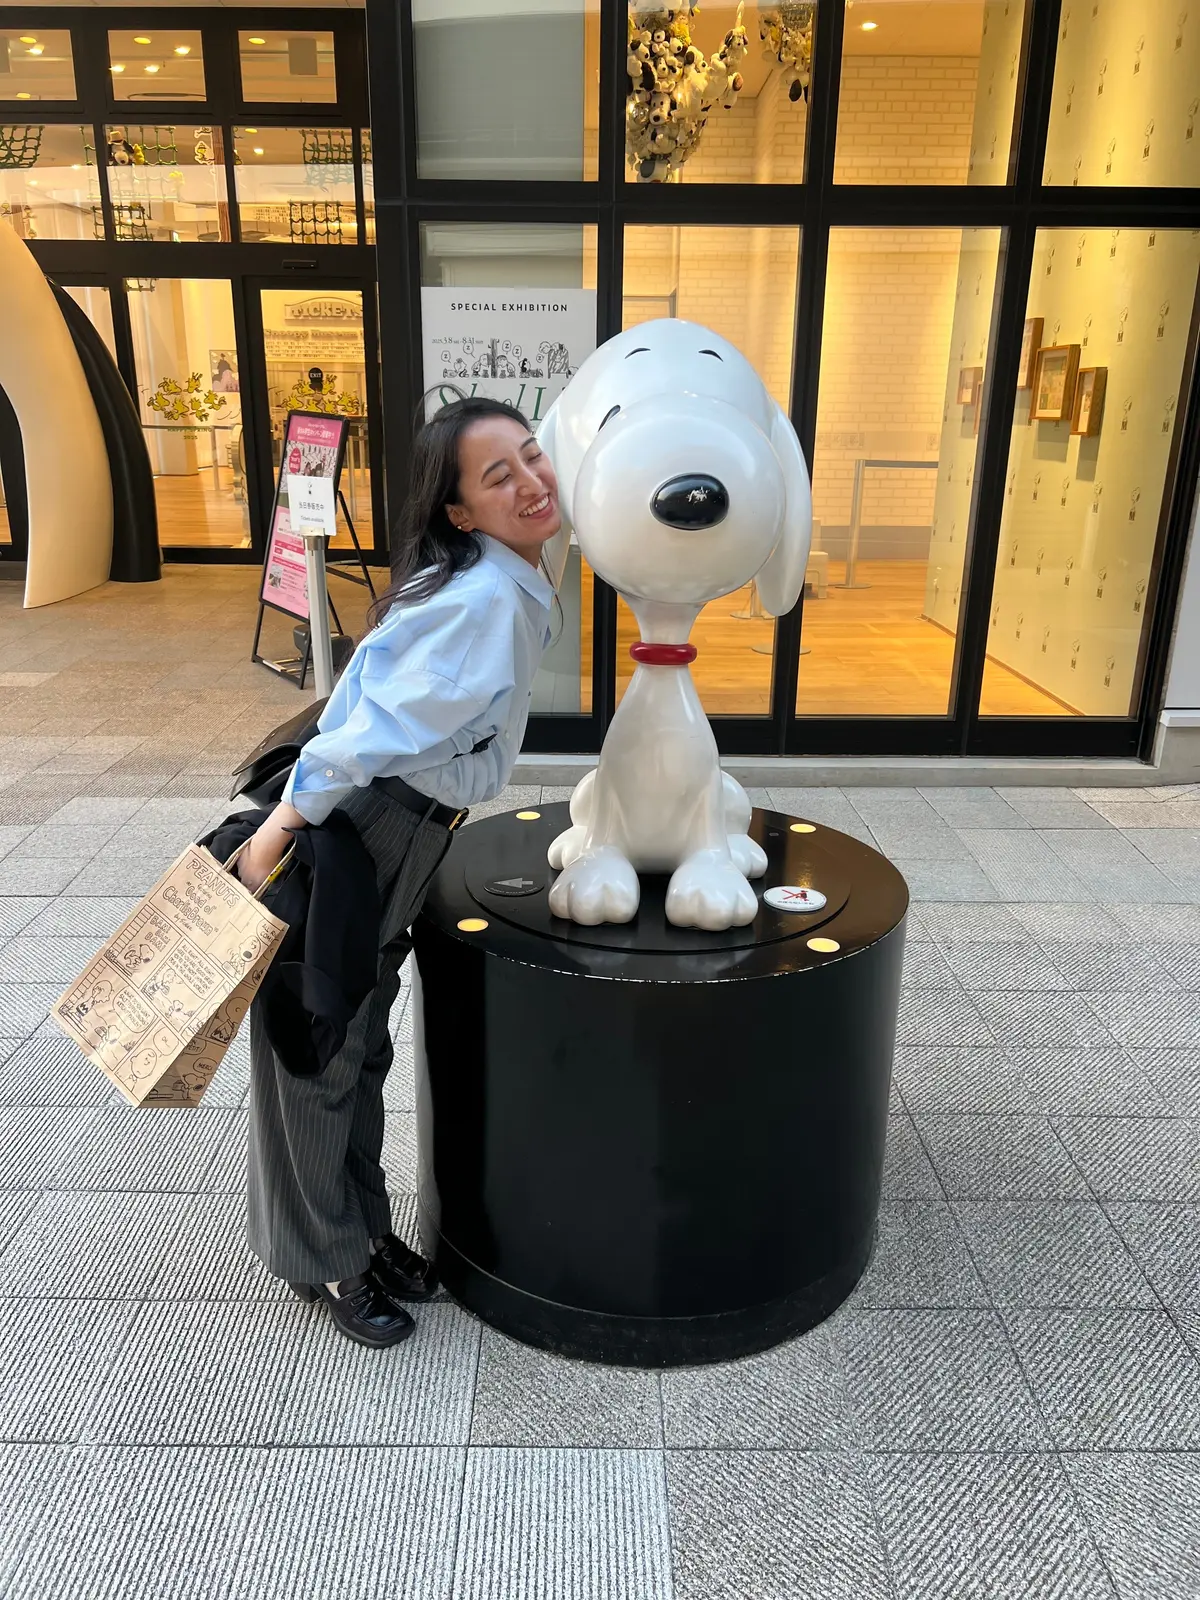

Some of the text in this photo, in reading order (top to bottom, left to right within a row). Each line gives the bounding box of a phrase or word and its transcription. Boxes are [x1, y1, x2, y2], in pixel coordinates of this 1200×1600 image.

[451, 303, 568, 312] SPECIAL EXHIBITION
[185, 857, 240, 907] PEANUTS
